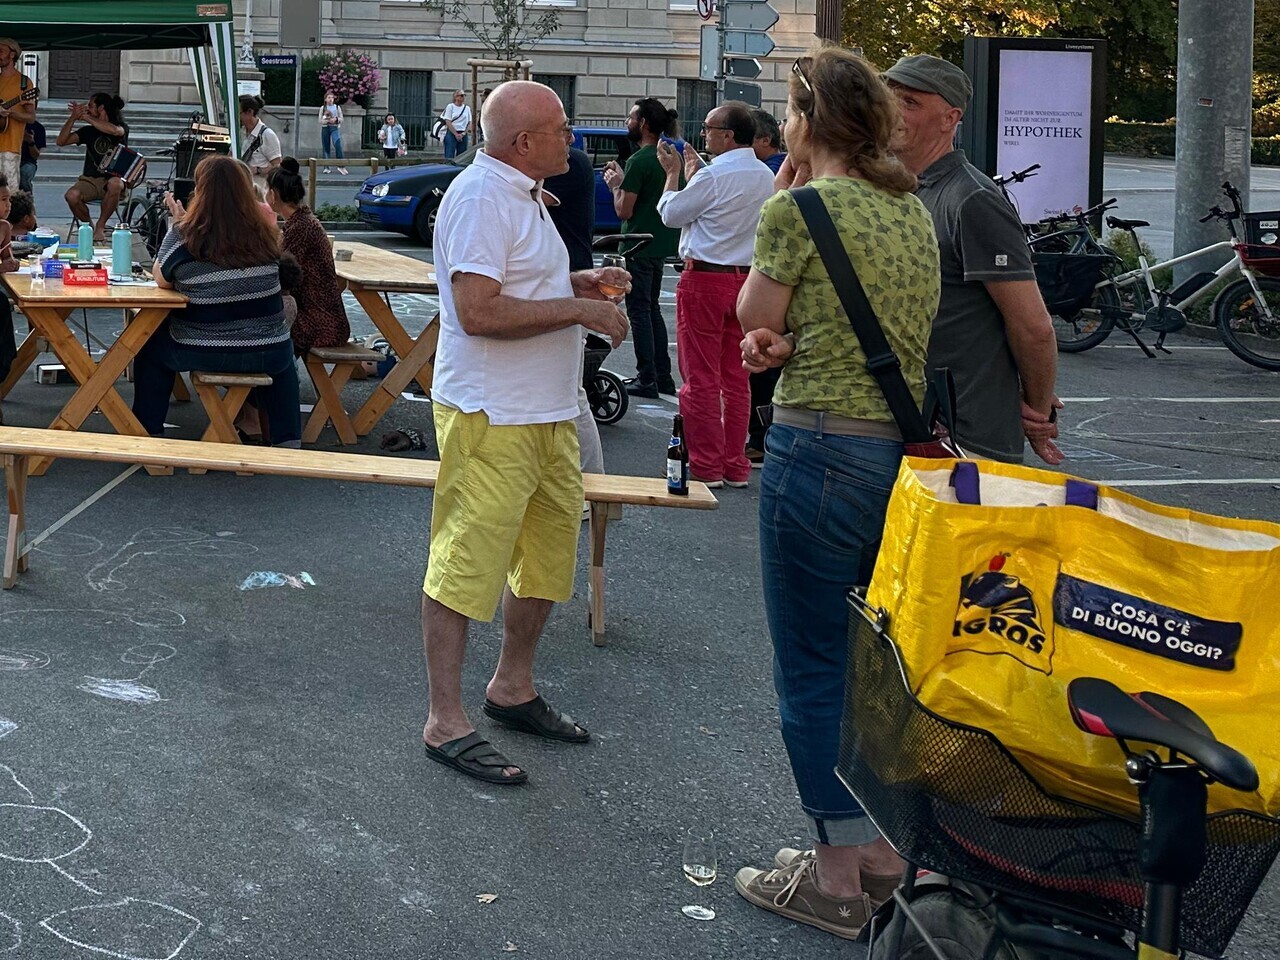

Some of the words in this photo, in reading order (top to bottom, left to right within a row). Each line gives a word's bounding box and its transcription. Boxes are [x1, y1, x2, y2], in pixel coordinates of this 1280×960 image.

[261, 57, 294, 65] Seestrasse
[1004, 125, 1083, 138] HYPOTHEK
[1111, 602, 1159, 627] COSA
[952, 616, 1047, 654] GROS
[1072, 606, 1090, 622] DI
[1094, 614, 1161, 644] BUONO
[1166, 637, 1222, 660] OGGI?
